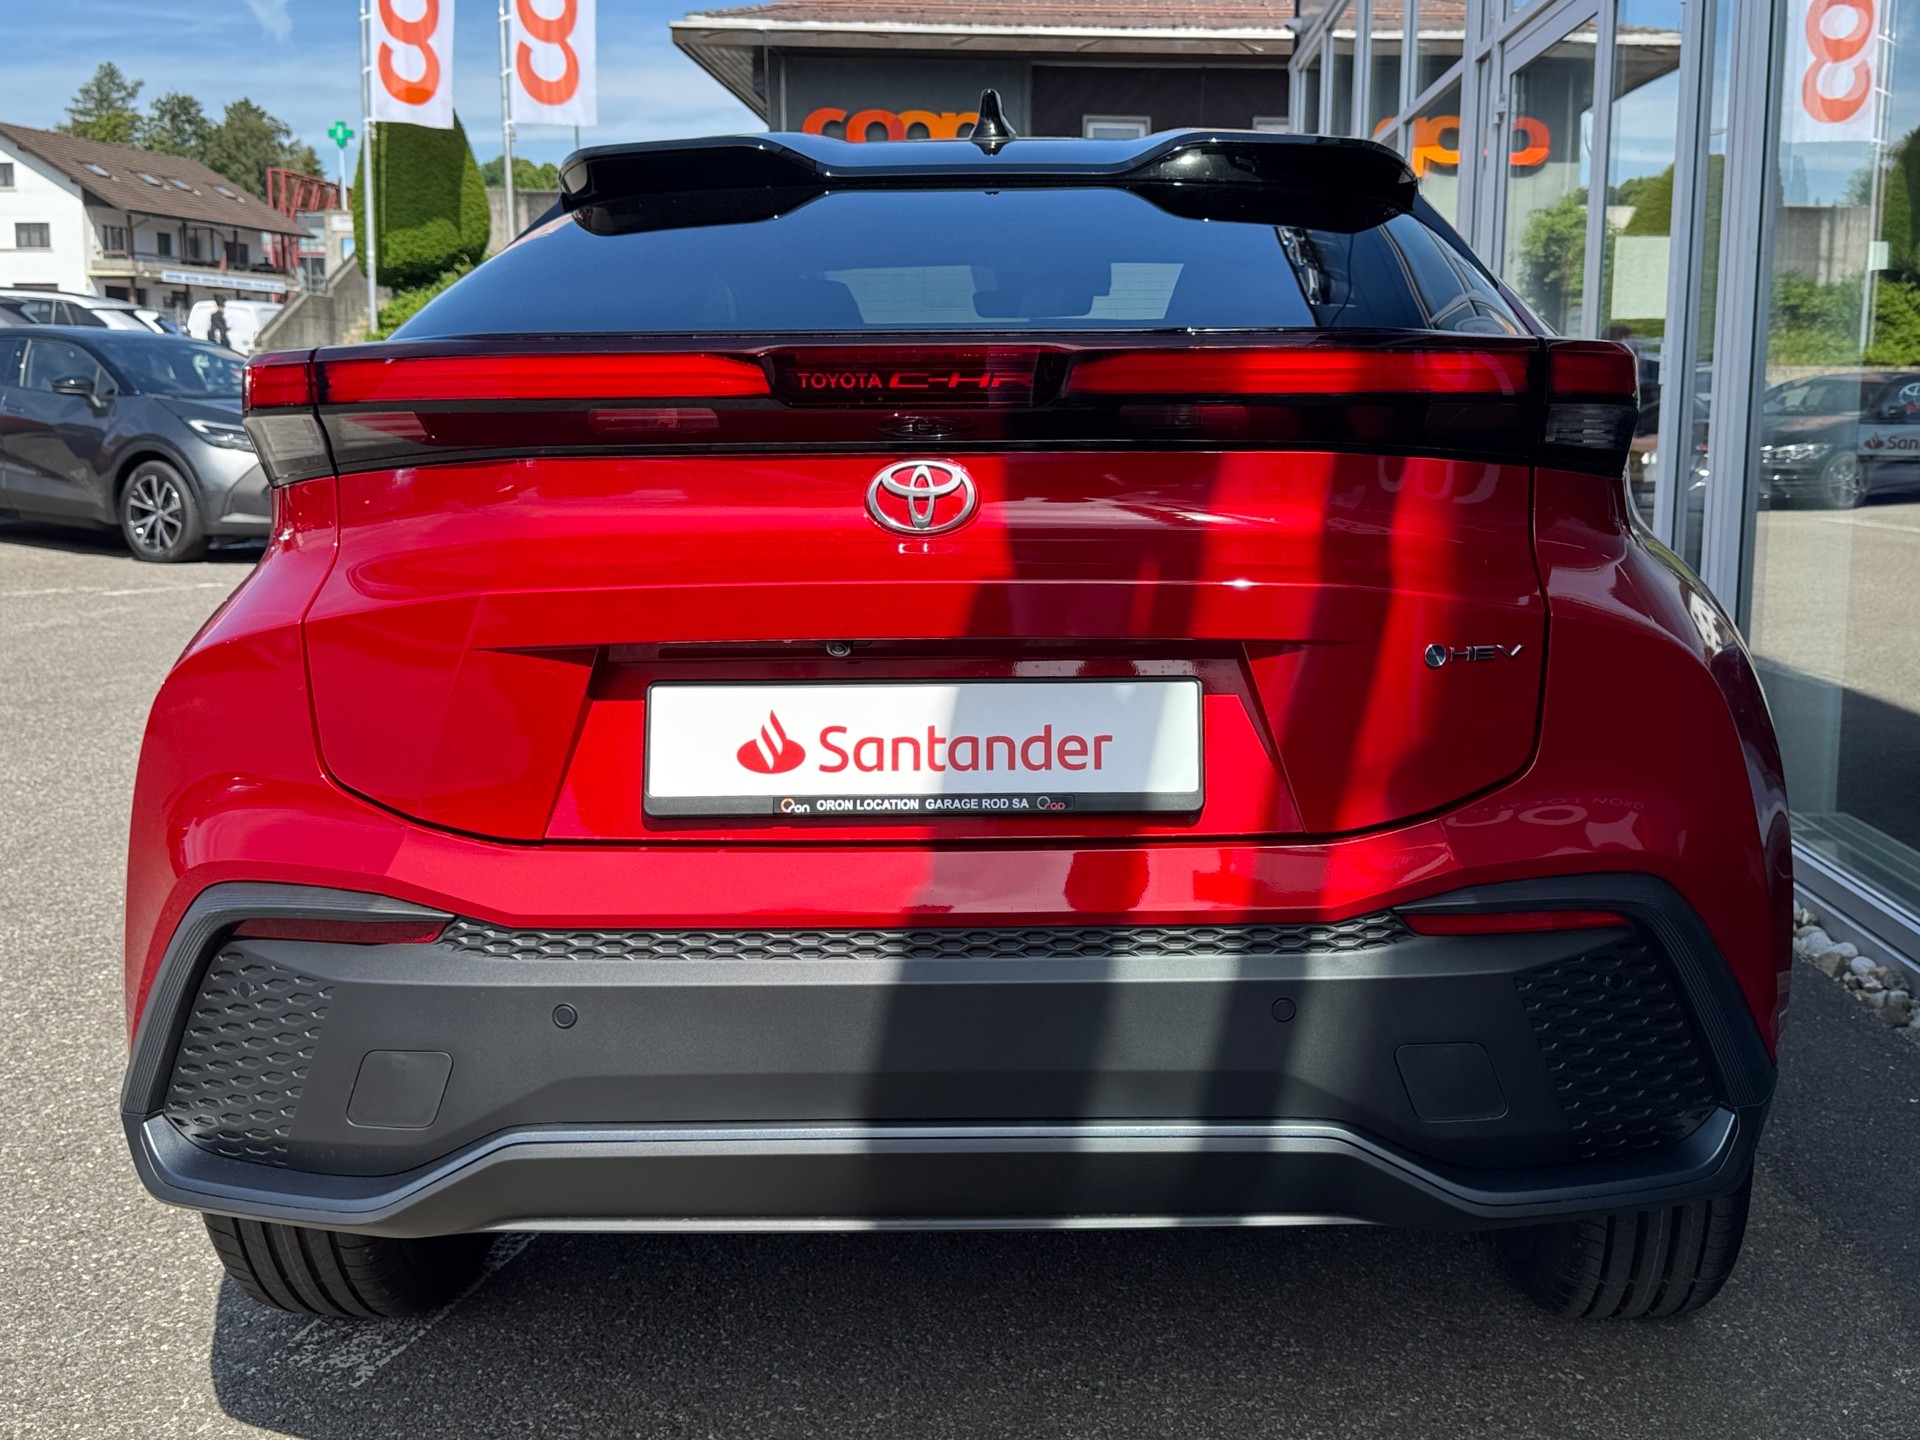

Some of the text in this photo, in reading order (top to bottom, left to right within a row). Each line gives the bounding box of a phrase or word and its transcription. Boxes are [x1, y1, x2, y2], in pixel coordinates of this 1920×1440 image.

[797, 373, 1033, 388] TOYOTA C-HR
[1887, 435, 1920, 450] San
[1449, 644, 1524, 662] HEV
[819, 724, 1113, 773] Santander
[816, 799, 853, 811] ORON
[856, 799, 919, 811] LOCATION
[925, 798, 979, 810] GARAGE
[982, 798, 1009, 809] ROD
[1011, 798, 1029, 809] SA
